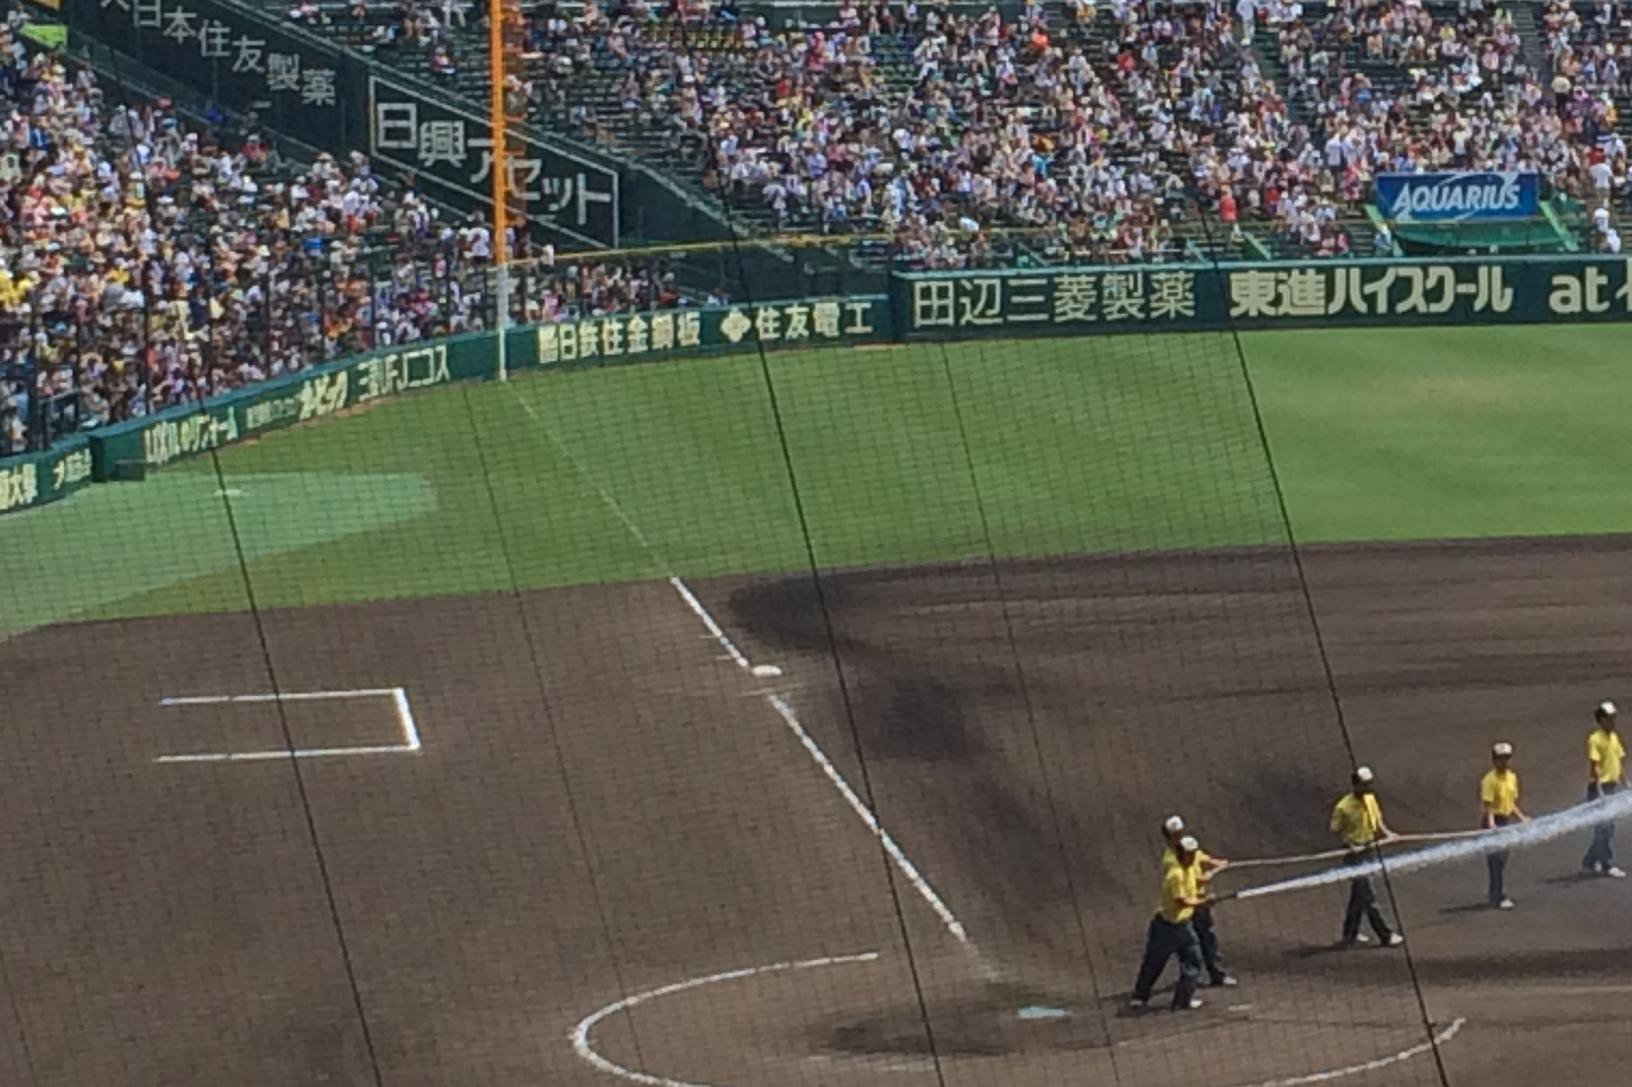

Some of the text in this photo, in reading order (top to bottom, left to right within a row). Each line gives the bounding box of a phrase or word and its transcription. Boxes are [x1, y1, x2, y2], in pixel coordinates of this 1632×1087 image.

[377, 103, 611, 225] 日興アセット
[1392, 181, 1521, 222] AQUARIUS
[913, 271, 1195, 328] 田辺三菱製薬
[1229, 265, 1513, 317] 東進ハイスクール
[756, 302, 873, 341] 住友電工
